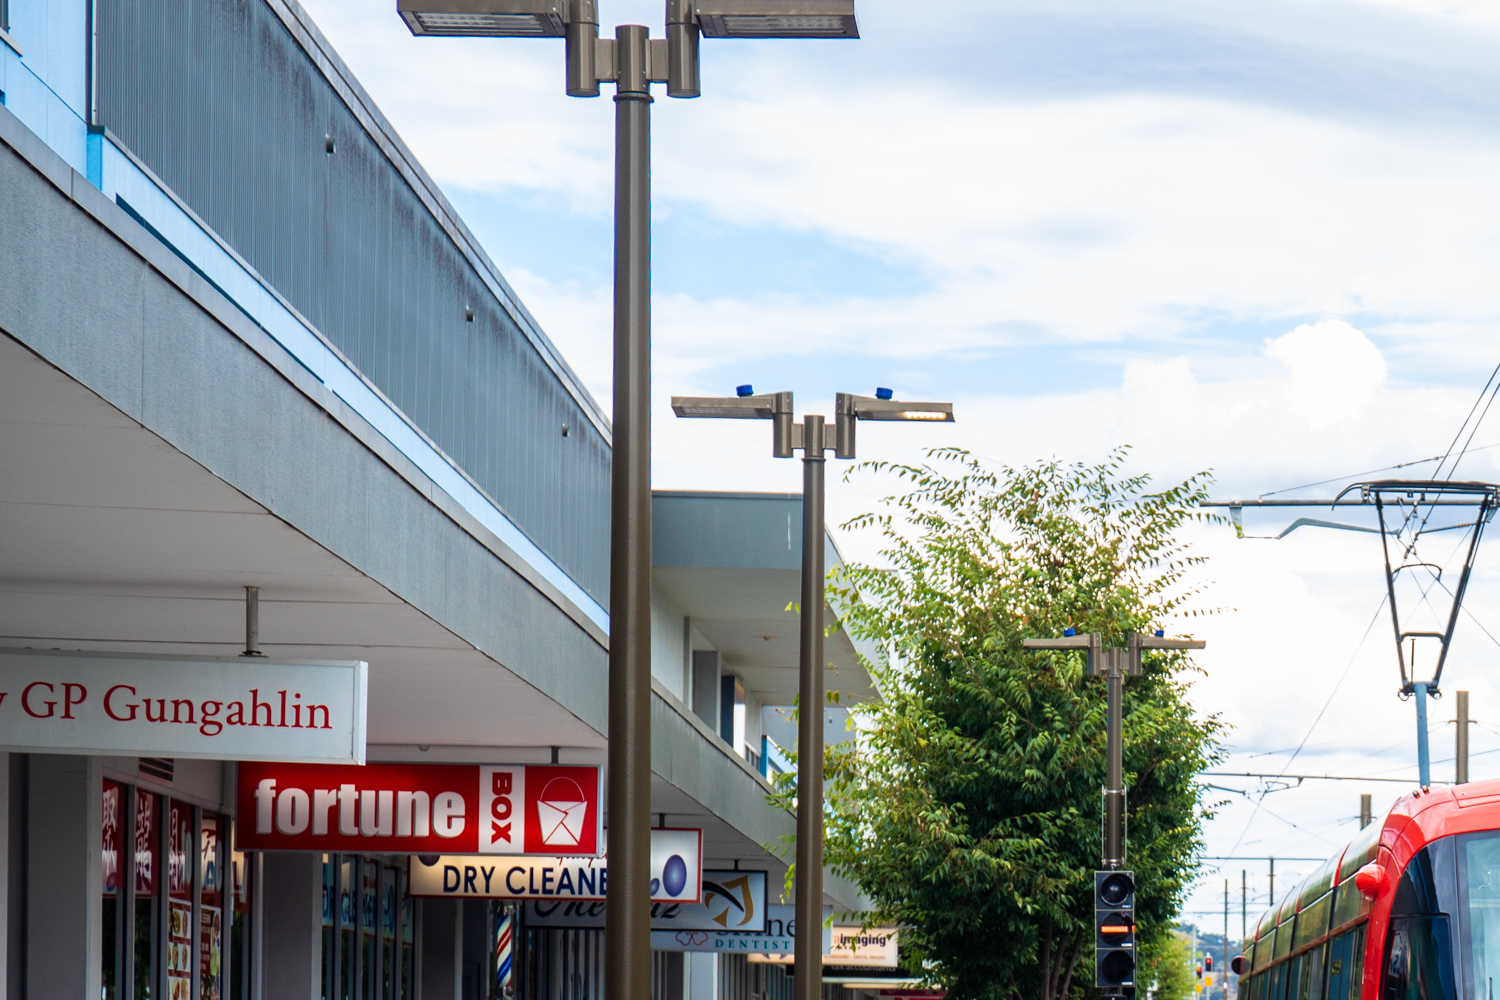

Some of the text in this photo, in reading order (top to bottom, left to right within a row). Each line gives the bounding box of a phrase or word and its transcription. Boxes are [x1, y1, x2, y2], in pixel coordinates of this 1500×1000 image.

[21, 681, 333, 736] GP Gungahlin
[254, 778, 467, 838] fortune
[490, 771, 512, 845] BOX
[443, 865, 495, 894] DRY
